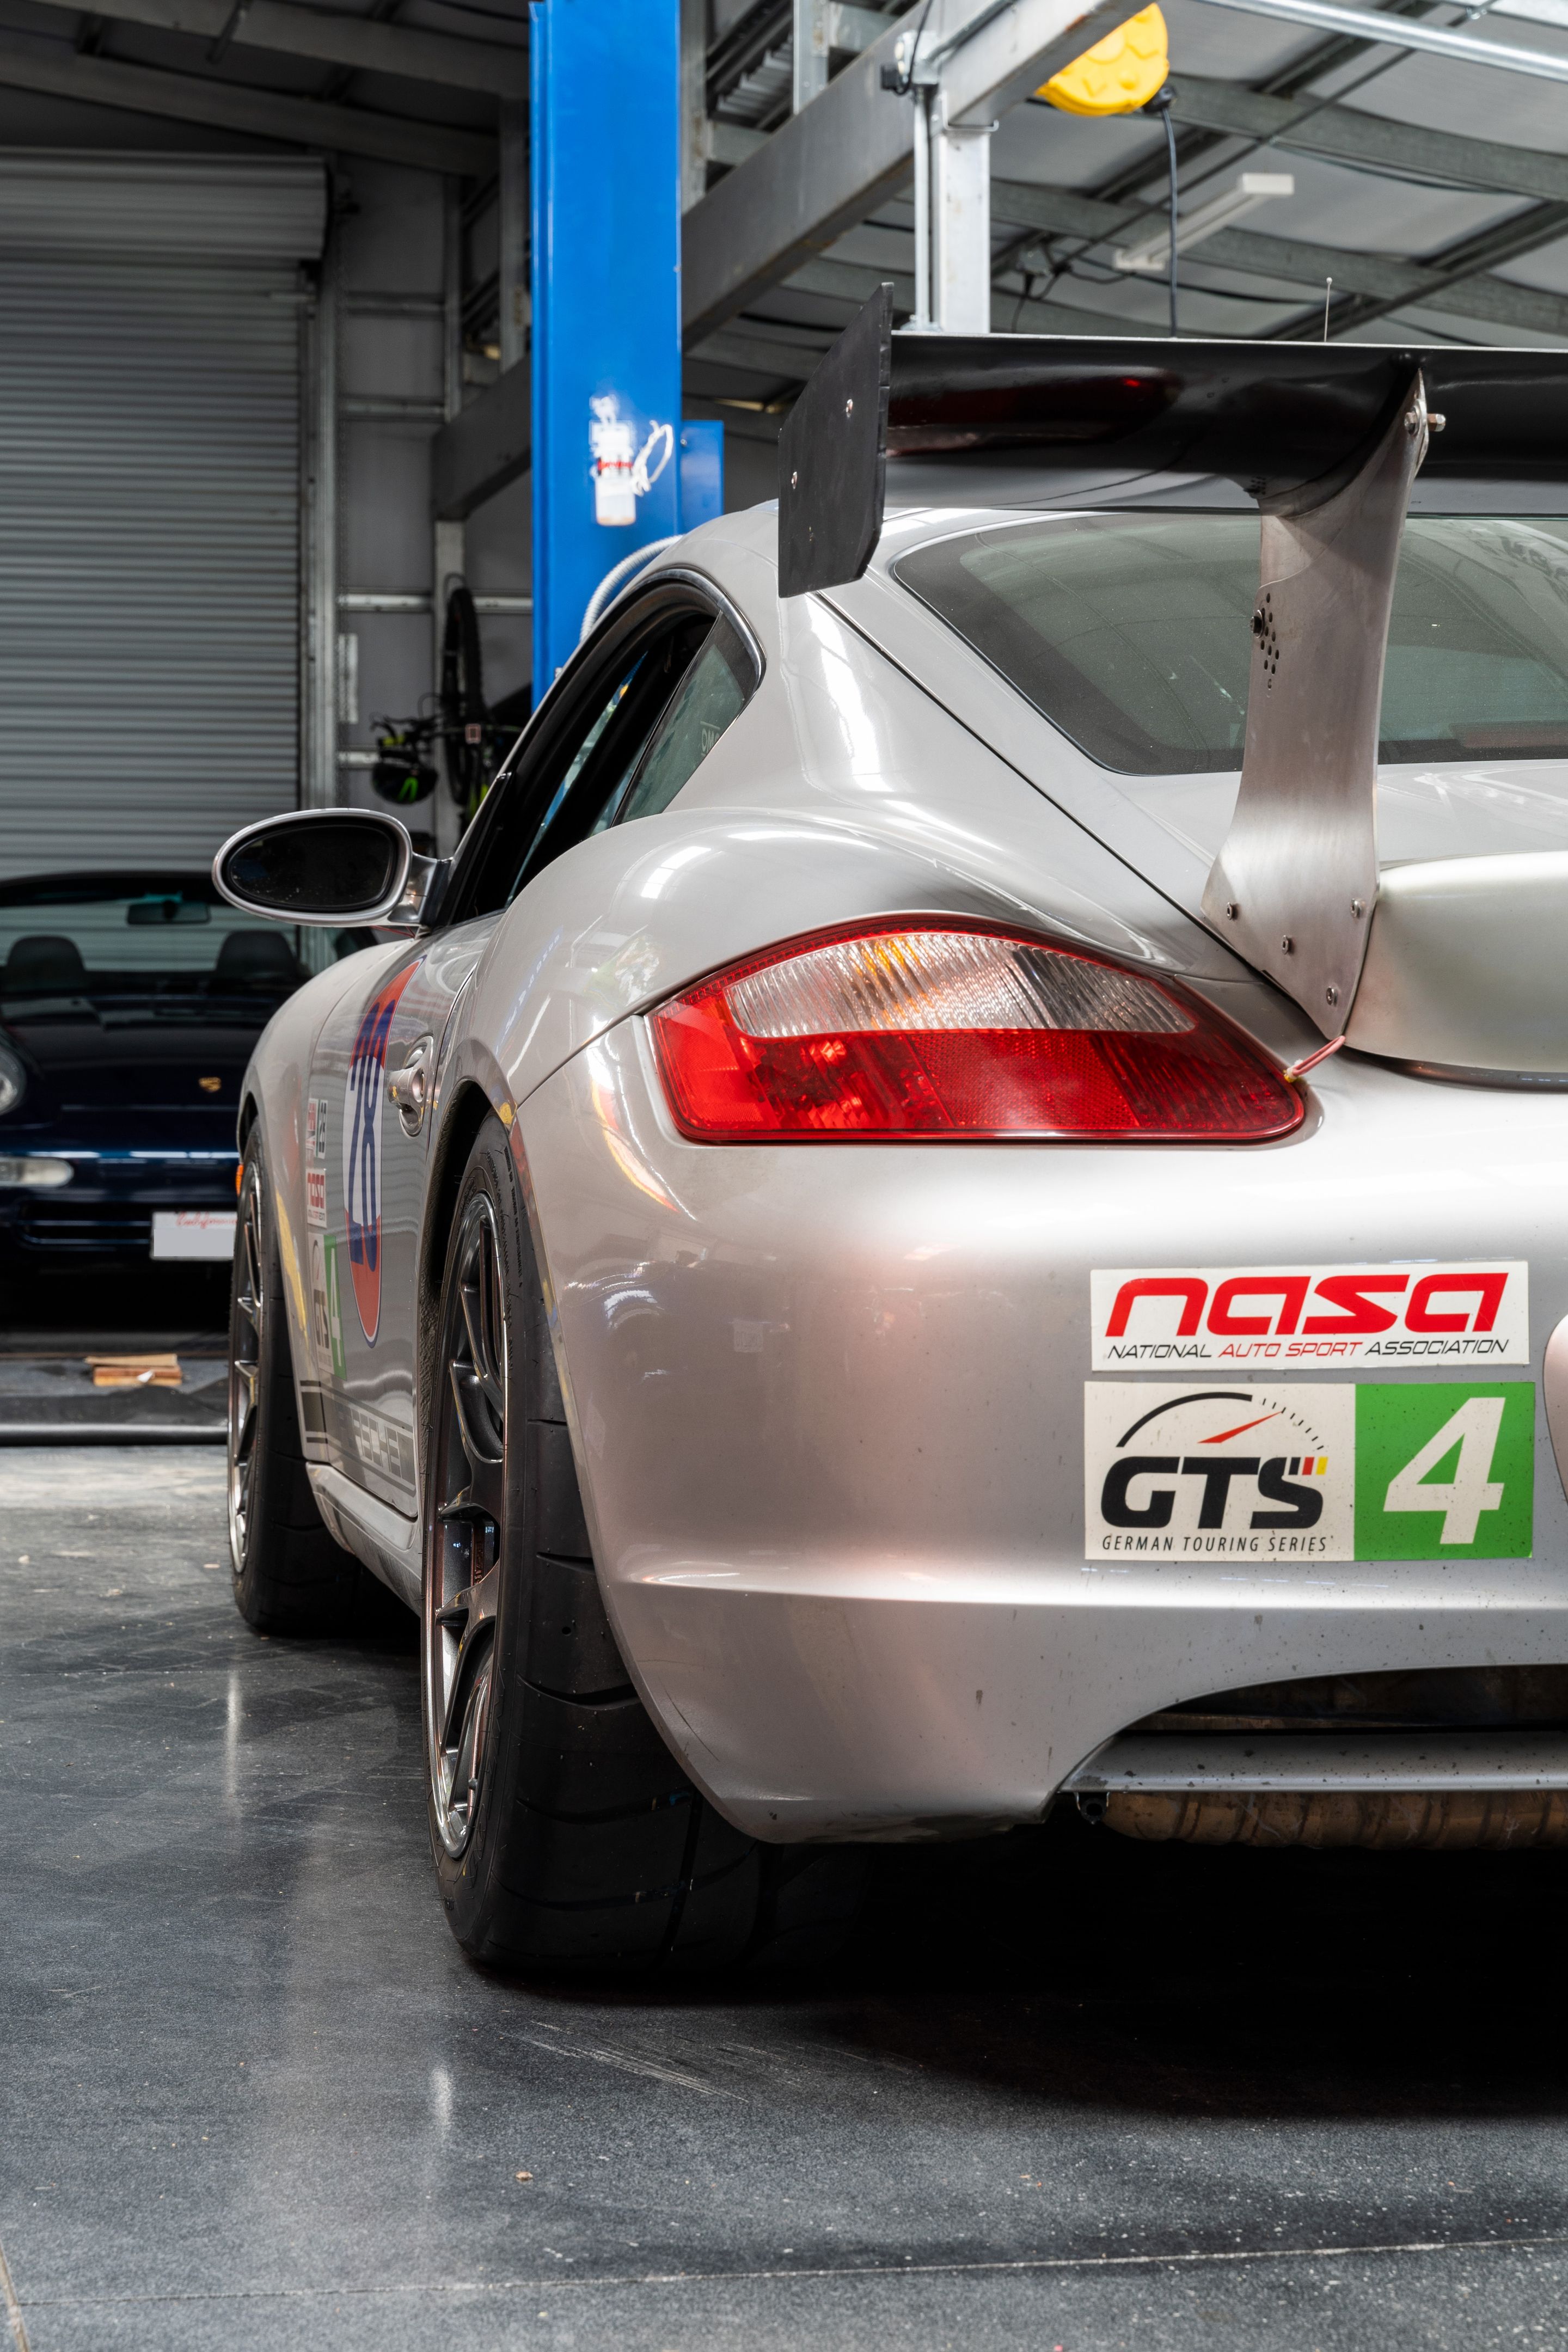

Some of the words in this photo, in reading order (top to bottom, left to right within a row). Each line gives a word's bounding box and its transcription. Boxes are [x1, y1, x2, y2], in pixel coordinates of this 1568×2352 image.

[1107, 1344, 1211, 1359] NATIONAL
[1218, 1343, 1281, 1358] AUTO
[1285, 1342, 1363, 1357] SPORT
[1365, 1339, 1509, 1356] ASSOCIATION
[1100, 1456, 1328, 1529] GTS
[1383, 1397, 1505, 1545] 4
[1102, 1536, 1173, 1551] GERMAN
[1183, 1537, 1258, 1552] TOURING
[1269, 1537, 1326, 1552] SERIES
